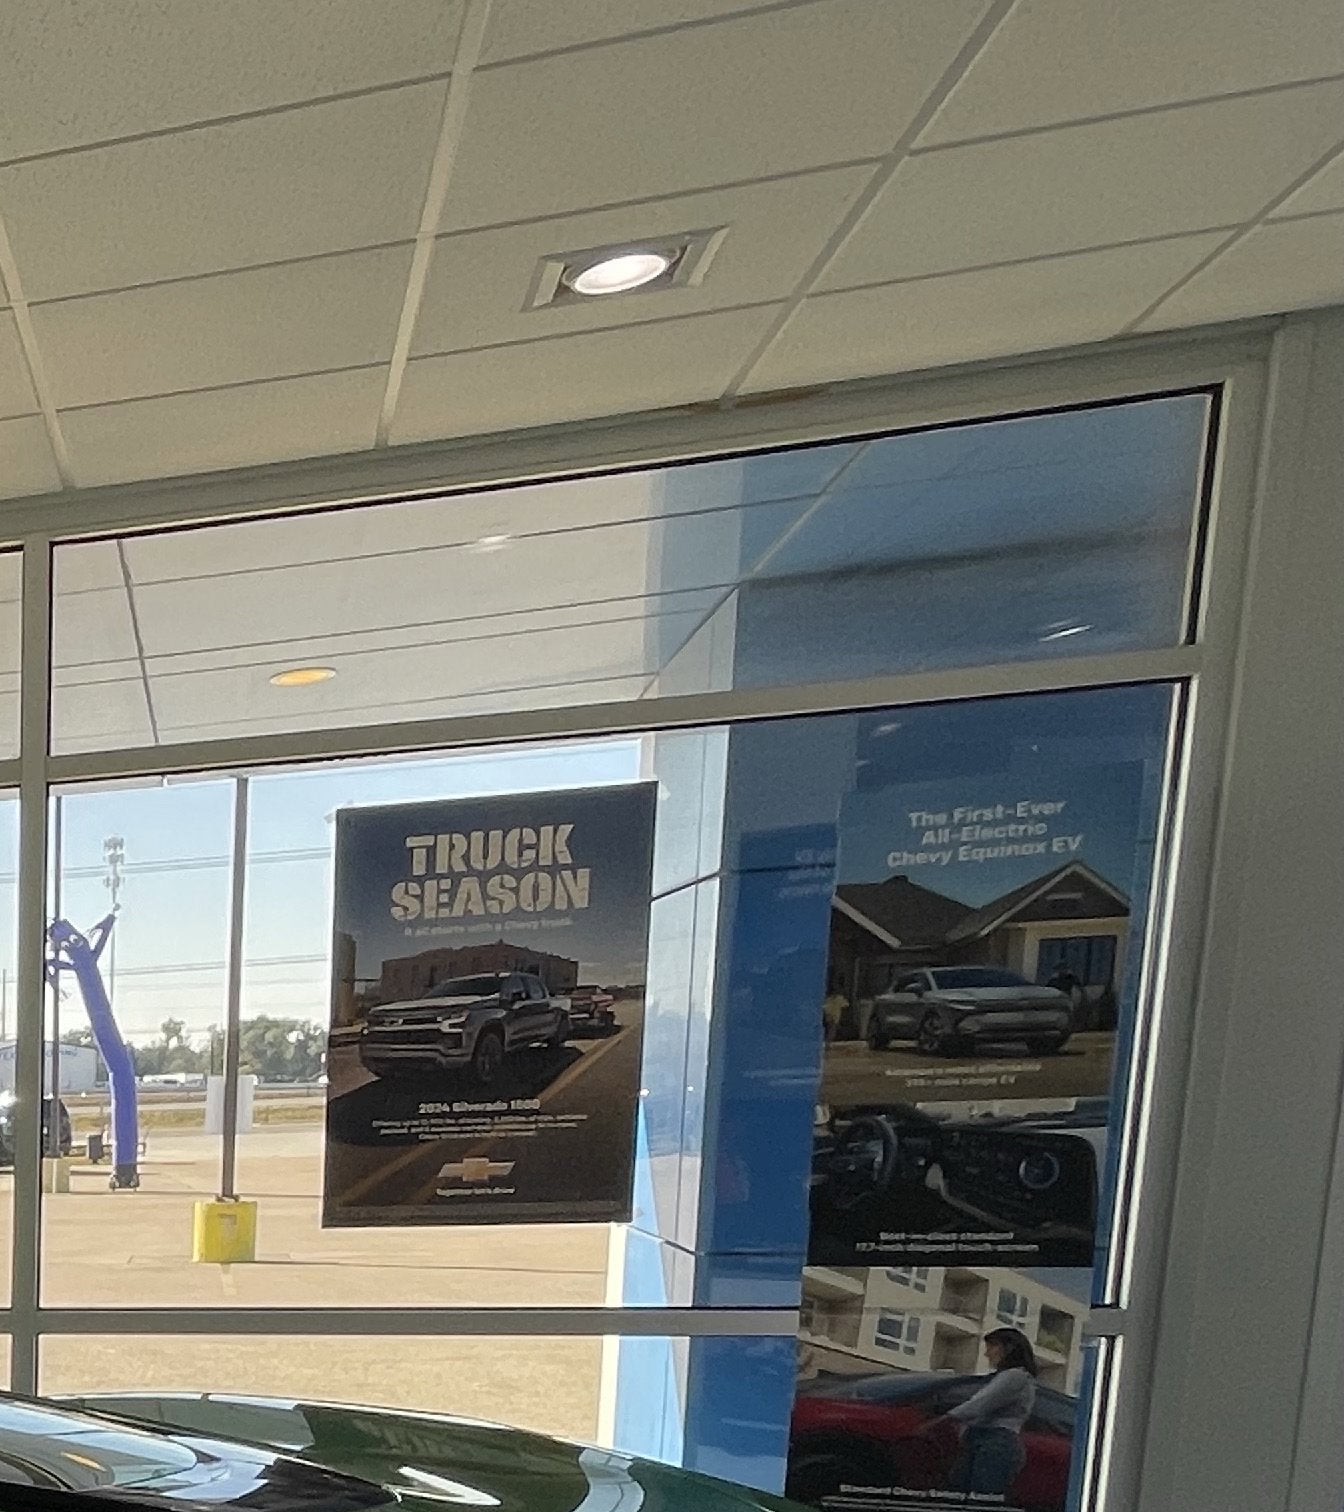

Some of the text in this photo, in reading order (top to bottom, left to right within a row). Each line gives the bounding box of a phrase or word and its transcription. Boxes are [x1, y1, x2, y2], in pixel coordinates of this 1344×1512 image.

[909, 800, 1068, 828] The First-Ever
[405, 823, 575, 877] TRUCK
[887, 834, 1084, 867] Chevy Equinox EV
[922, 822, 1049, 846] All-Electric
[390, 867, 592, 922] SEASON
